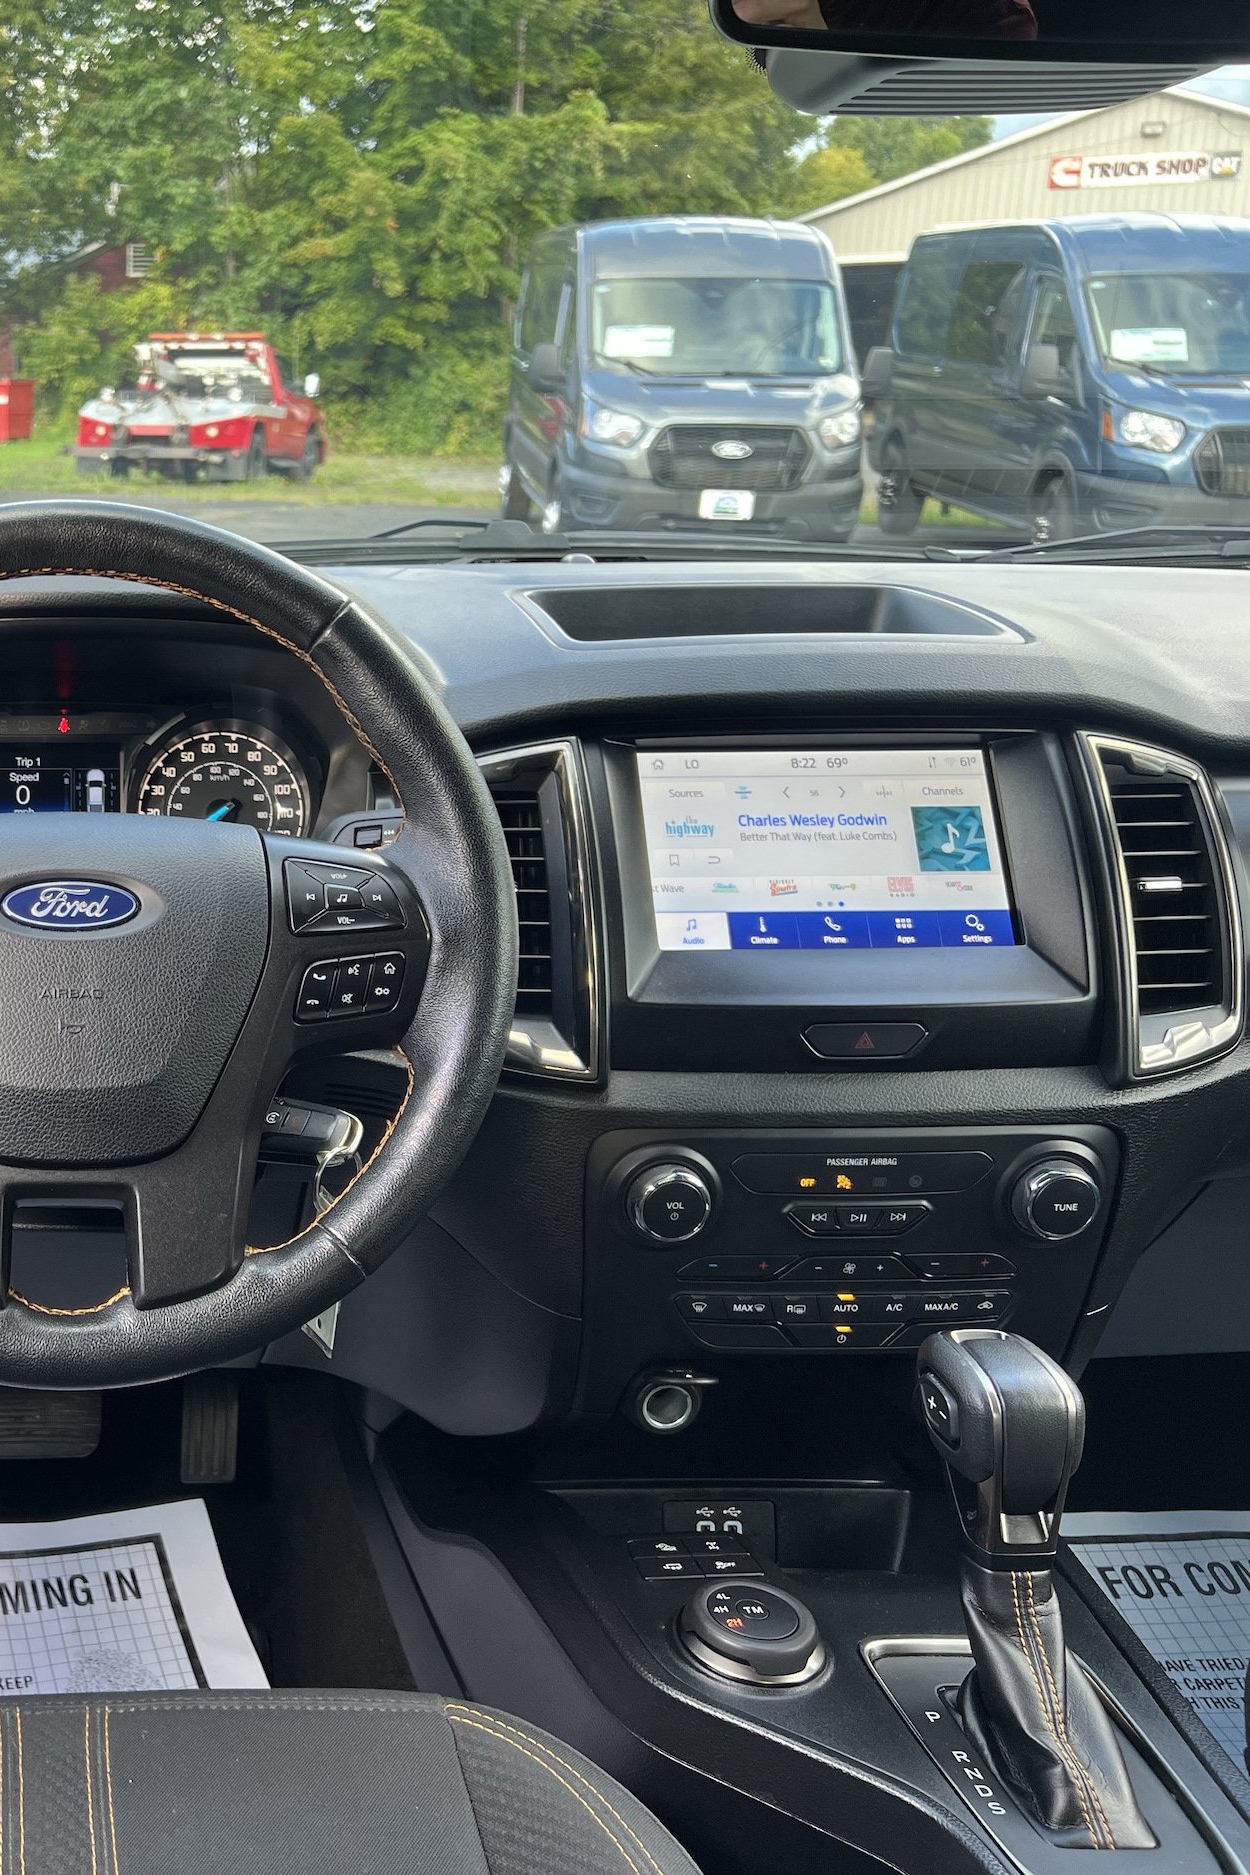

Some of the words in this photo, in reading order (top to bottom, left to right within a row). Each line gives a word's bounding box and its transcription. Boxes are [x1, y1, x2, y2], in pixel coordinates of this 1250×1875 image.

[1088, 162, 1148, 178] TRUCK
[1156, 157, 1208, 175] SHOP
[201, 743, 216, 753] 60
[224, 743, 239, 753] 70
[180, 752, 195, 762] 50
[247, 751, 262, 762] 80
[15, 757, 34, 768] Trip
[36, 757, 41, 766] 1
[685, 759, 699, 769] LO
[791, 758, 817, 769] 8:22
[162, 767, 176, 778] 40
[263, 765, 277, 775] 90
[9, 772, 40, 784] Speed
[151, 785, 165, 795] 30
[274, 784, 290, 795] 100
[669, 789, 703, 798] Sources
[922, 787, 964, 796] Channels
[15, 785, 31, 805] 0
[738, 814, 787, 827] Charles
[789, 814, 835, 828] Wesley
[838, 814, 887, 827] Godwin
[665, 820, 714, 838] highway
[740, 832, 768, 841] Better
[769, 832, 790, 841] That
[792, 832, 812, 842] Way
[840, 831, 861, 841] Luke
[862, 831, 897, 842] Combs)
[661, 885, 684, 893] Wave
[31, 887, 109, 918] Ford
[683, 937, 705, 945] Audio
[751, 936, 778, 945] Climate
[823, 936, 847, 944] Phone
[897, 935, 916, 945] Apps
[962, 934, 993, 944] Settings
[40, 988, 104, 999] AIRBAG
[826, 1158, 869, 1166] PASSENGER
[870, 1157, 898, 1166] AIRBAG
[800, 1178, 817, 1187] OFF
[666, 1202, 684, 1210] VOL
[1054, 1203, 1078, 1212] TUNE
[733, 1304, 754, 1312] MAX
[833, 1304, 858, 1312] AUTO
[886, 1303, 903, 1312] A/C
[105, 1567, 142, 1601] IN
[1097, 1564, 1184, 1600] FOR
[713, 1605, 729, 1613] 4H
[742, 1606, 764, 1614] TM
[726, 1618, 743, 1627] 2H
[1195, 1658, 1245, 1671] TRIED
[1183, 1677, 1245, 1690] CARPET
[1200, 1697, 1240, 1709] THIS
[925, 1710, 940, 1723] P
[951, 1750, 970, 1763] R
[964, 1767, 984, 1780] N
[974, 1784, 993, 1797] D
[988, 1802, 1006, 1815] S
